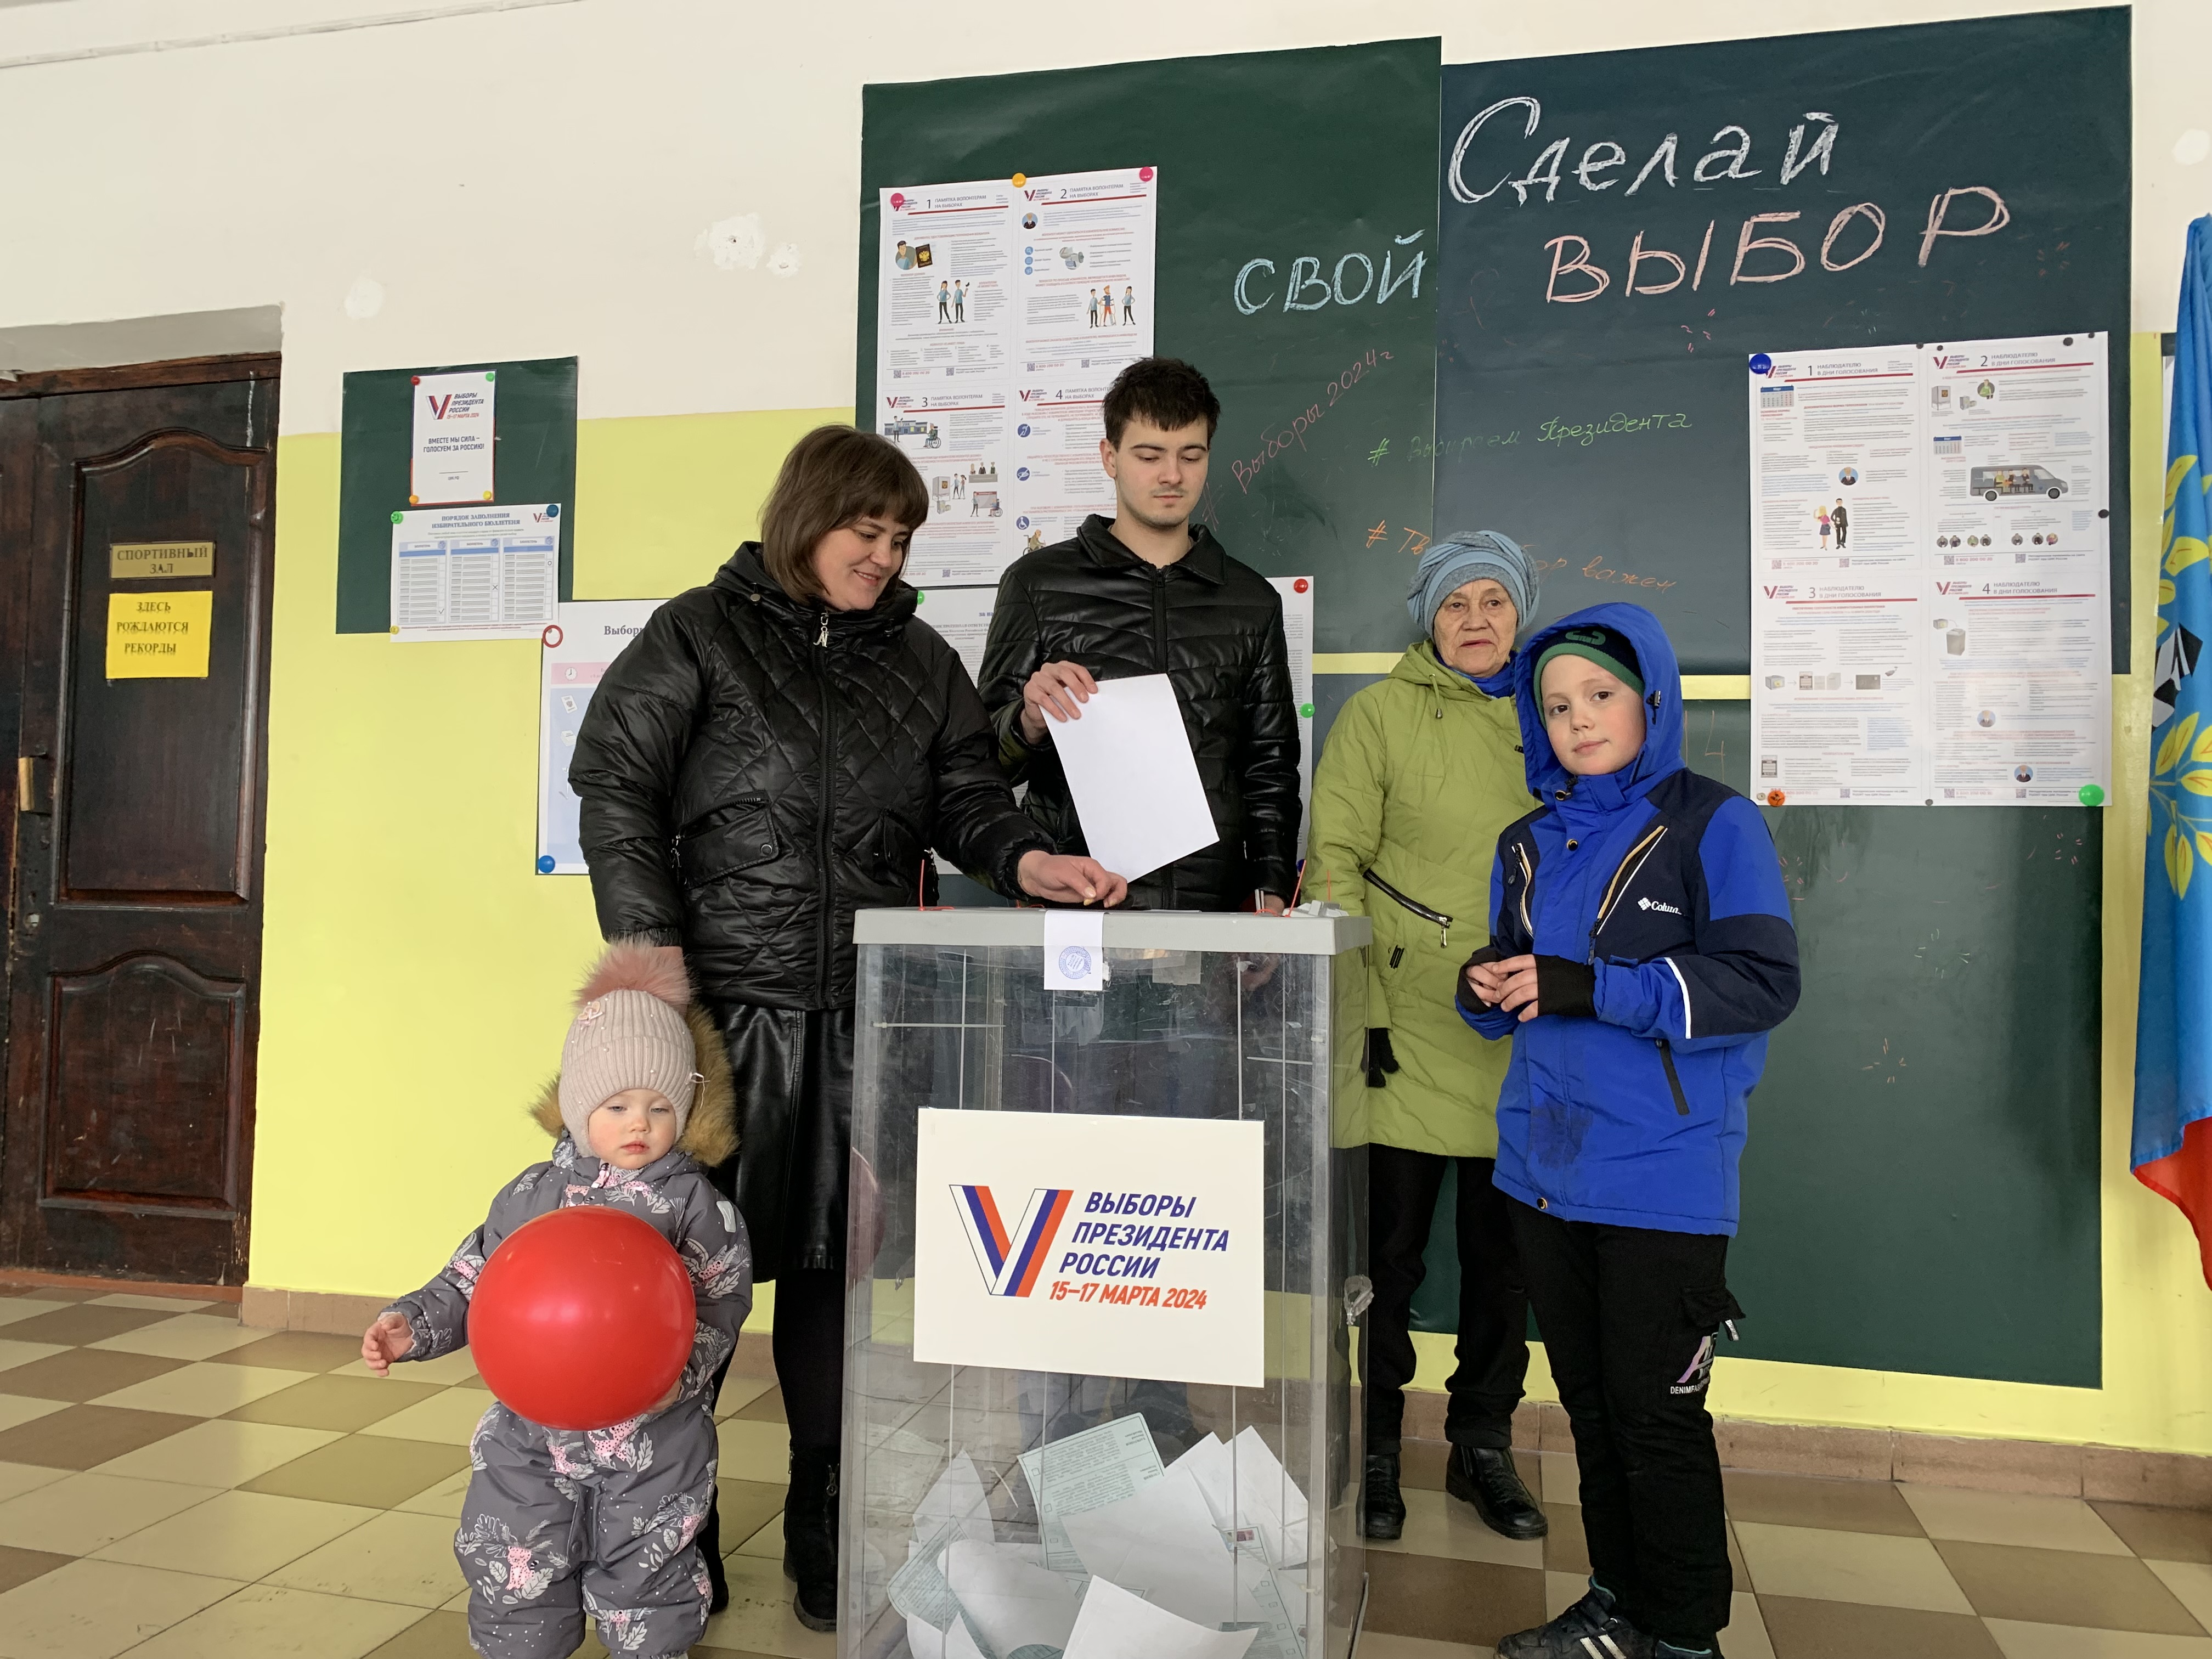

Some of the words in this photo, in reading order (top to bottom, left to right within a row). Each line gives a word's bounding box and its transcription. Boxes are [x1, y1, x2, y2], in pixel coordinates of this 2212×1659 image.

[1449, 97, 1839, 205] Сделай
[1060, 189, 1067, 199] 2
[927, 199, 931, 208] 1
[1545, 185, 2010, 306] ВЫБОР
[1980, 356, 1988, 366] 2
[1808, 366, 1813, 376] 1
[1056, 390, 1063, 399] 4
[922, 397, 928, 407] 3
[1538, 413, 1692, 447] Президента
[1232, 404, 1325, 494] Выборы
[117, 545, 207, 560] СПОРТИВНЫЙ
[150, 563, 173, 574] ЗАЛ
[1809, 588, 1815, 598] 3
[1982, 583, 1990, 594] 4
[136, 602, 171, 612] ЗДЕСЬ
[117, 622, 188, 632] РОЖДАЮТСЯ
[125, 643, 176, 653] РЕКОРДЫ
[1084, 1192, 1196, 1218] ВЫБОРЫ
[1071, 1222, 1229, 1252] ПРЕЗИДЕНТА
[1059, 1252, 1161, 1279] РОССИИ
[1049, 1281, 1100, 1302] 15–17
[1099, 1284, 1158, 1307] МАРТА
[1162, 1289, 1208, 1310] 2024
